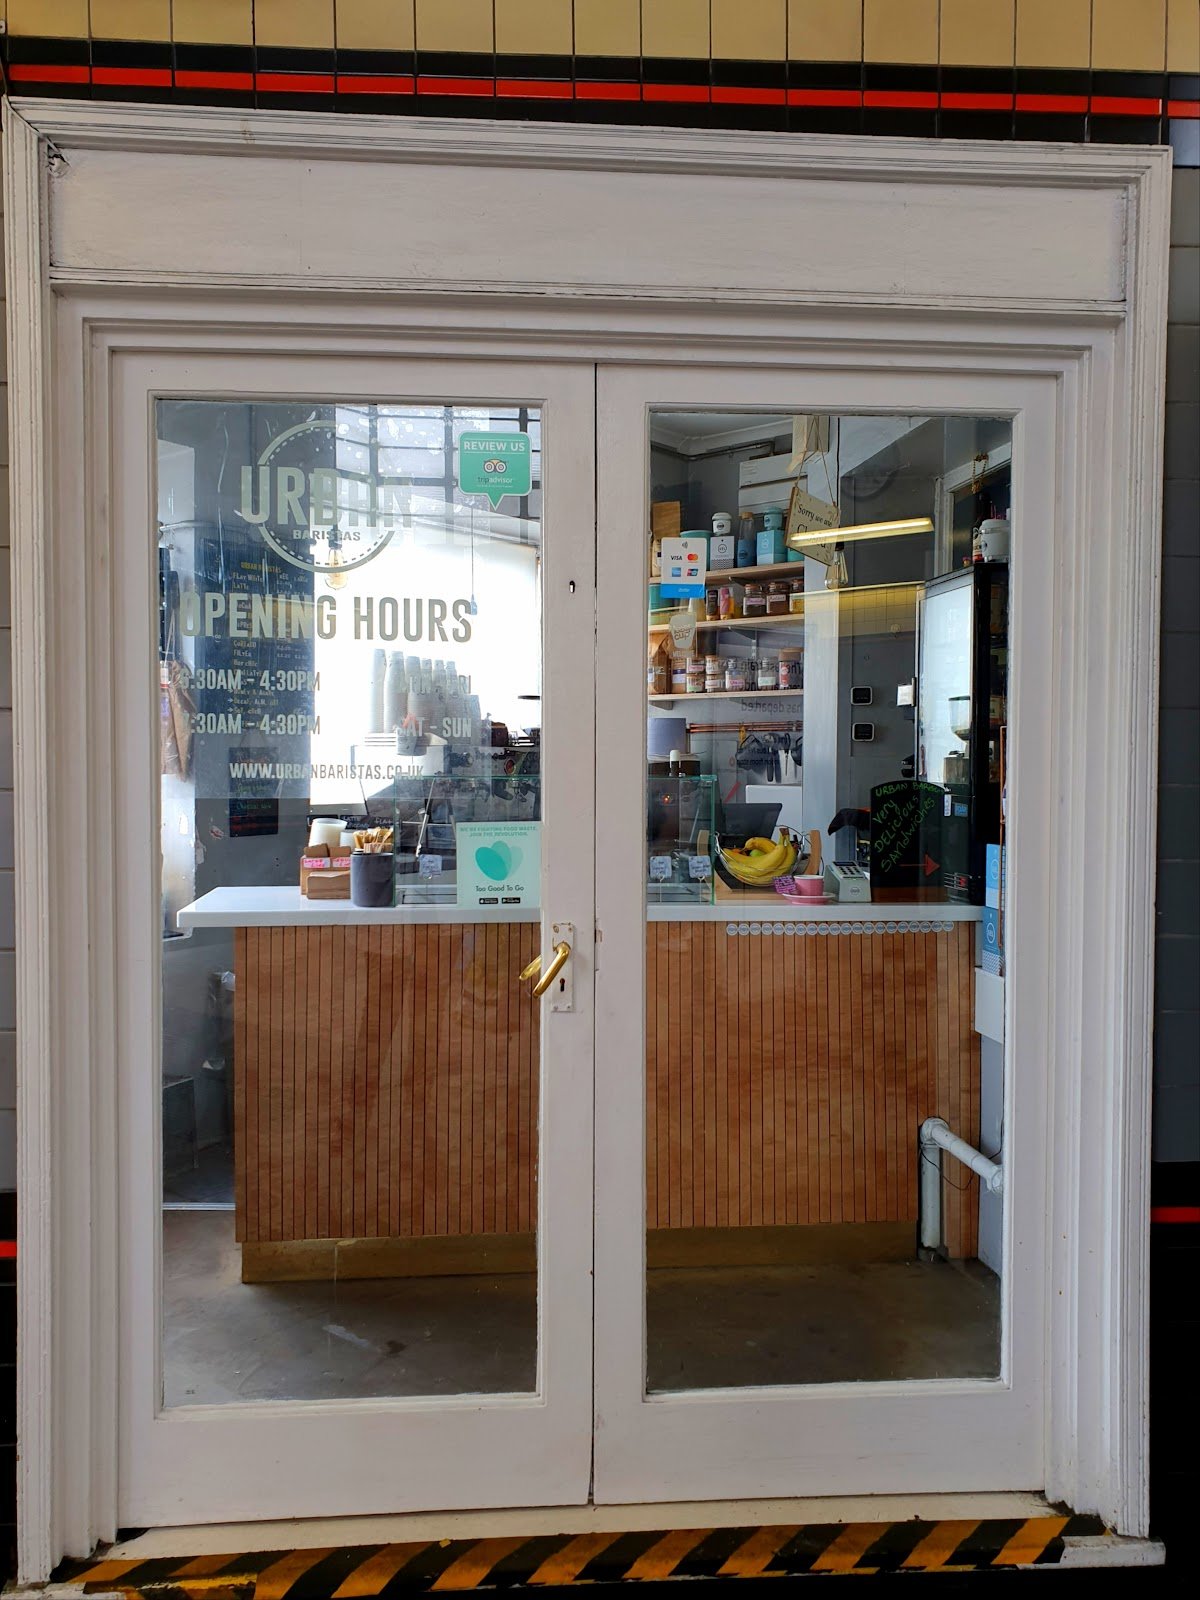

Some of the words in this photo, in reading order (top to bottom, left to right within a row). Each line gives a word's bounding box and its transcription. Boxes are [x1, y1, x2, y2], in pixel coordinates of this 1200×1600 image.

[464, 441, 507, 451] REVIEW
[510, 442, 525, 452] US
[241, 465, 413, 528] URBAN
[797, 504, 815, 521] Sorry
[815, 515, 823, 523] we
[824, 519, 833, 527] are
[292, 529, 361, 541] BARISTAS
[179, 592, 337, 640] OPENING
[354, 596, 472, 643] HOURS
[259, 670, 321, 692] 4:30PM
[259, 713, 321, 735] 4:30PM
[442, 716, 472, 738] SUN
[875, 783, 908, 797] URBAN
[487, 884, 505, 892] Good
